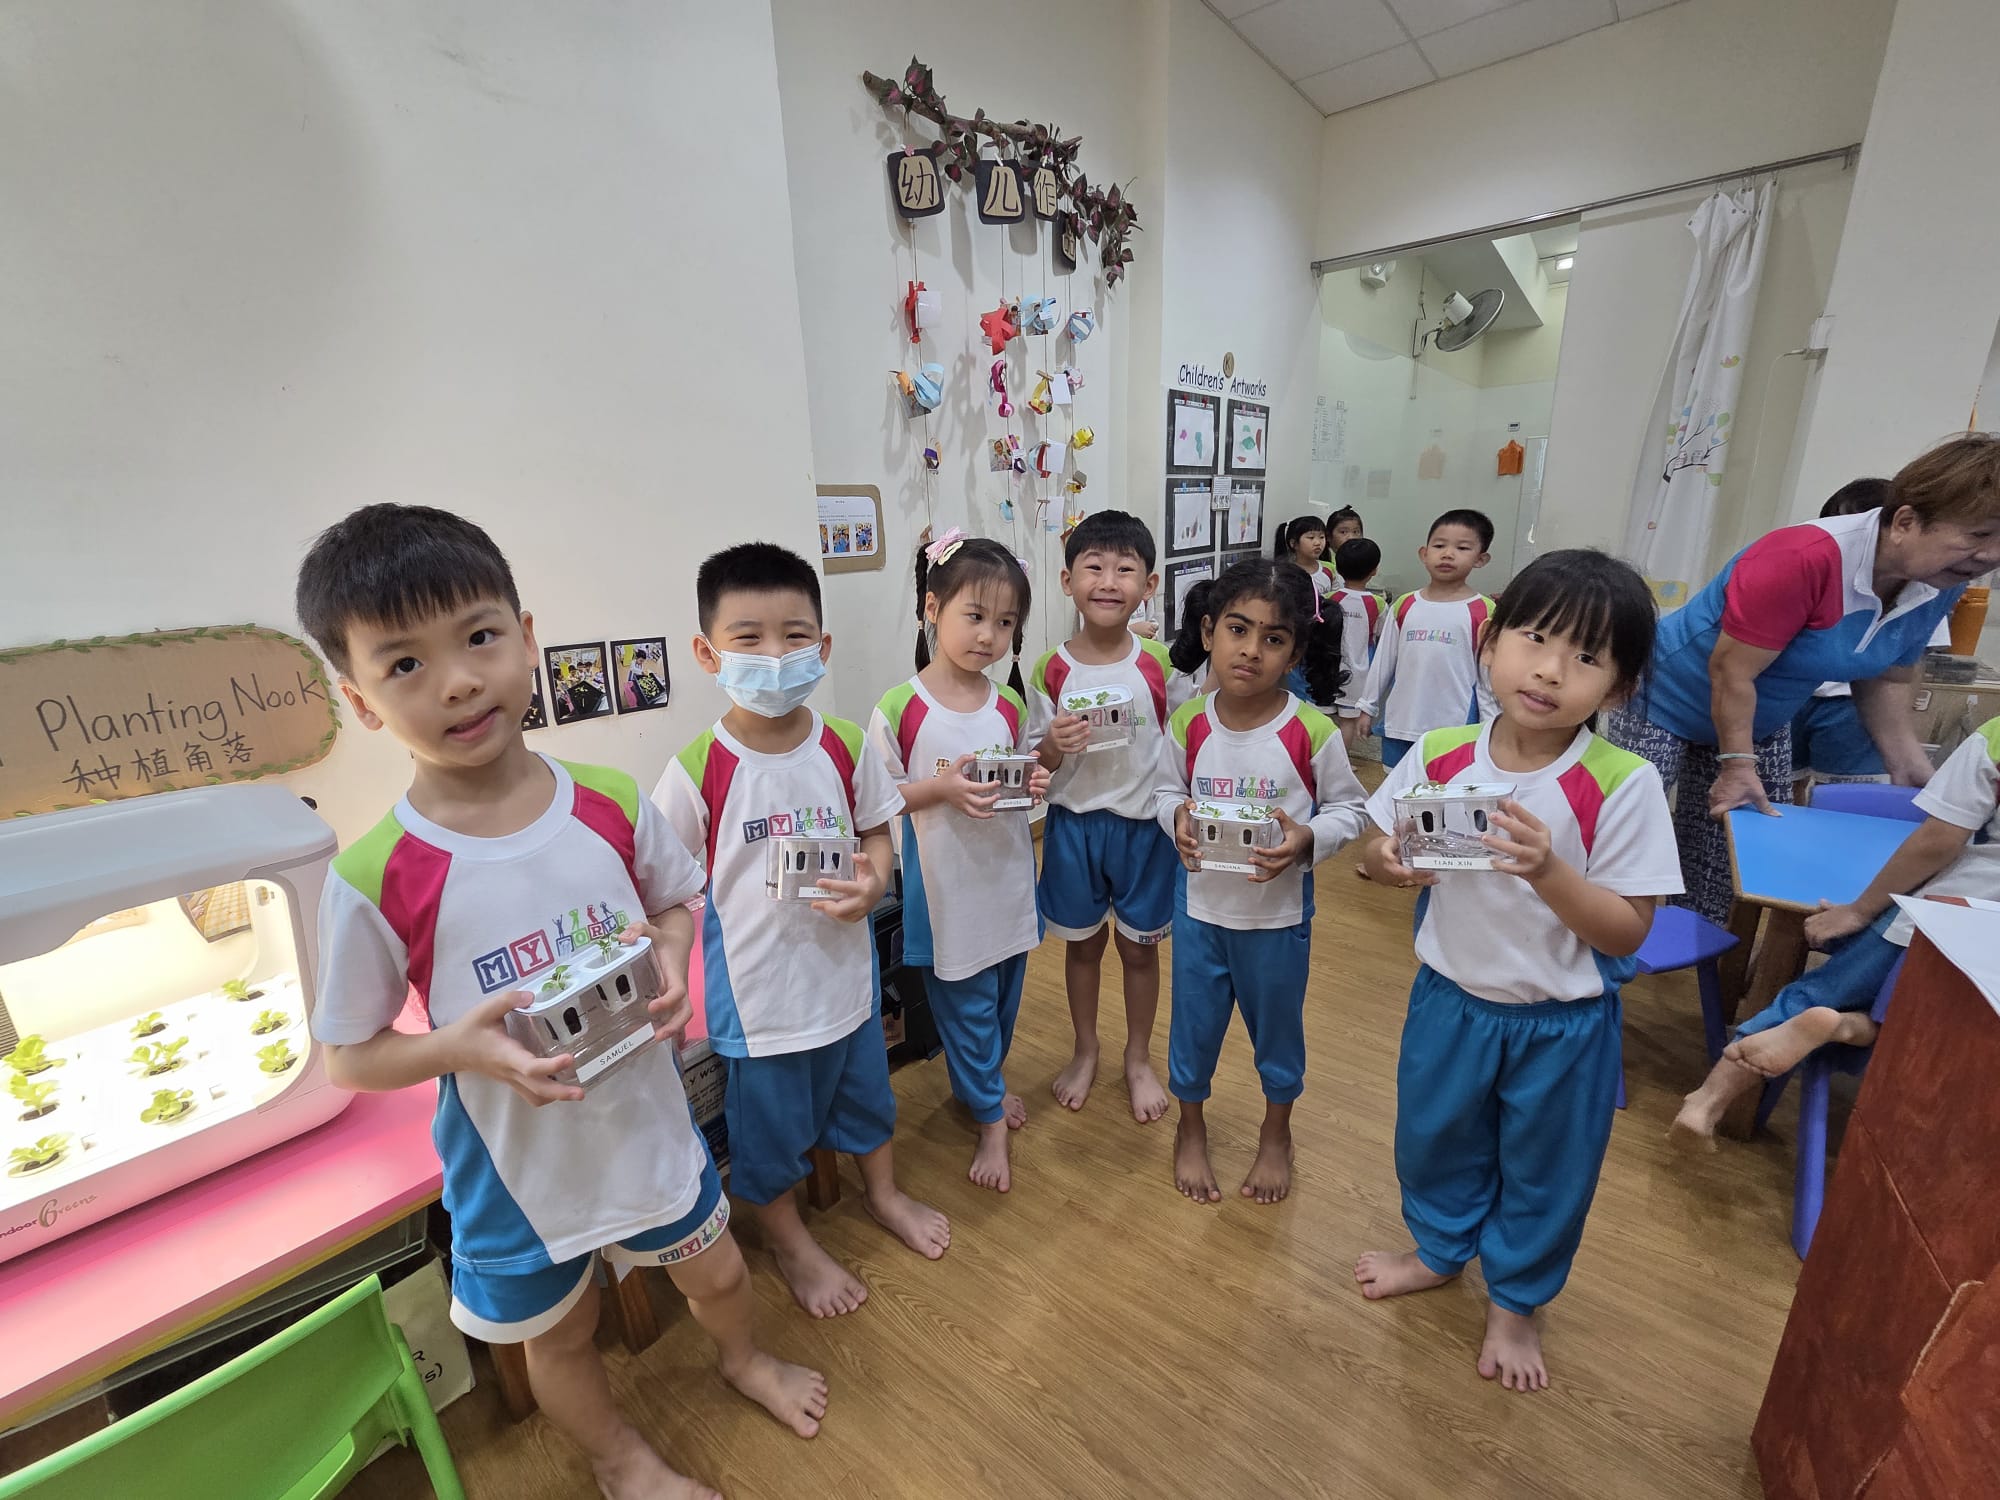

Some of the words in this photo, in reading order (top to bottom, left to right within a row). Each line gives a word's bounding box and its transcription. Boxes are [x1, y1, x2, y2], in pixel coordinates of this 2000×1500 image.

[900, 161, 936, 206] 幼
[1035, 171, 1056, 212] 作
[1179, 363, 1224, 391] Children's
[1230, 376, 1267, 396] Artworks
[36, 692, 228, 751] Planting
[230, 671, 326, 716] Nook
[61, 731, 255, 794] 种植角落
[1196, 776, 1233, 798] MY
[743, 813, 793, 844] MY
[472, 929, 554, 994] MY
[599, 1041, 634, 1066] SAMUEL
[39, 1194, 97, 1227] Greens
